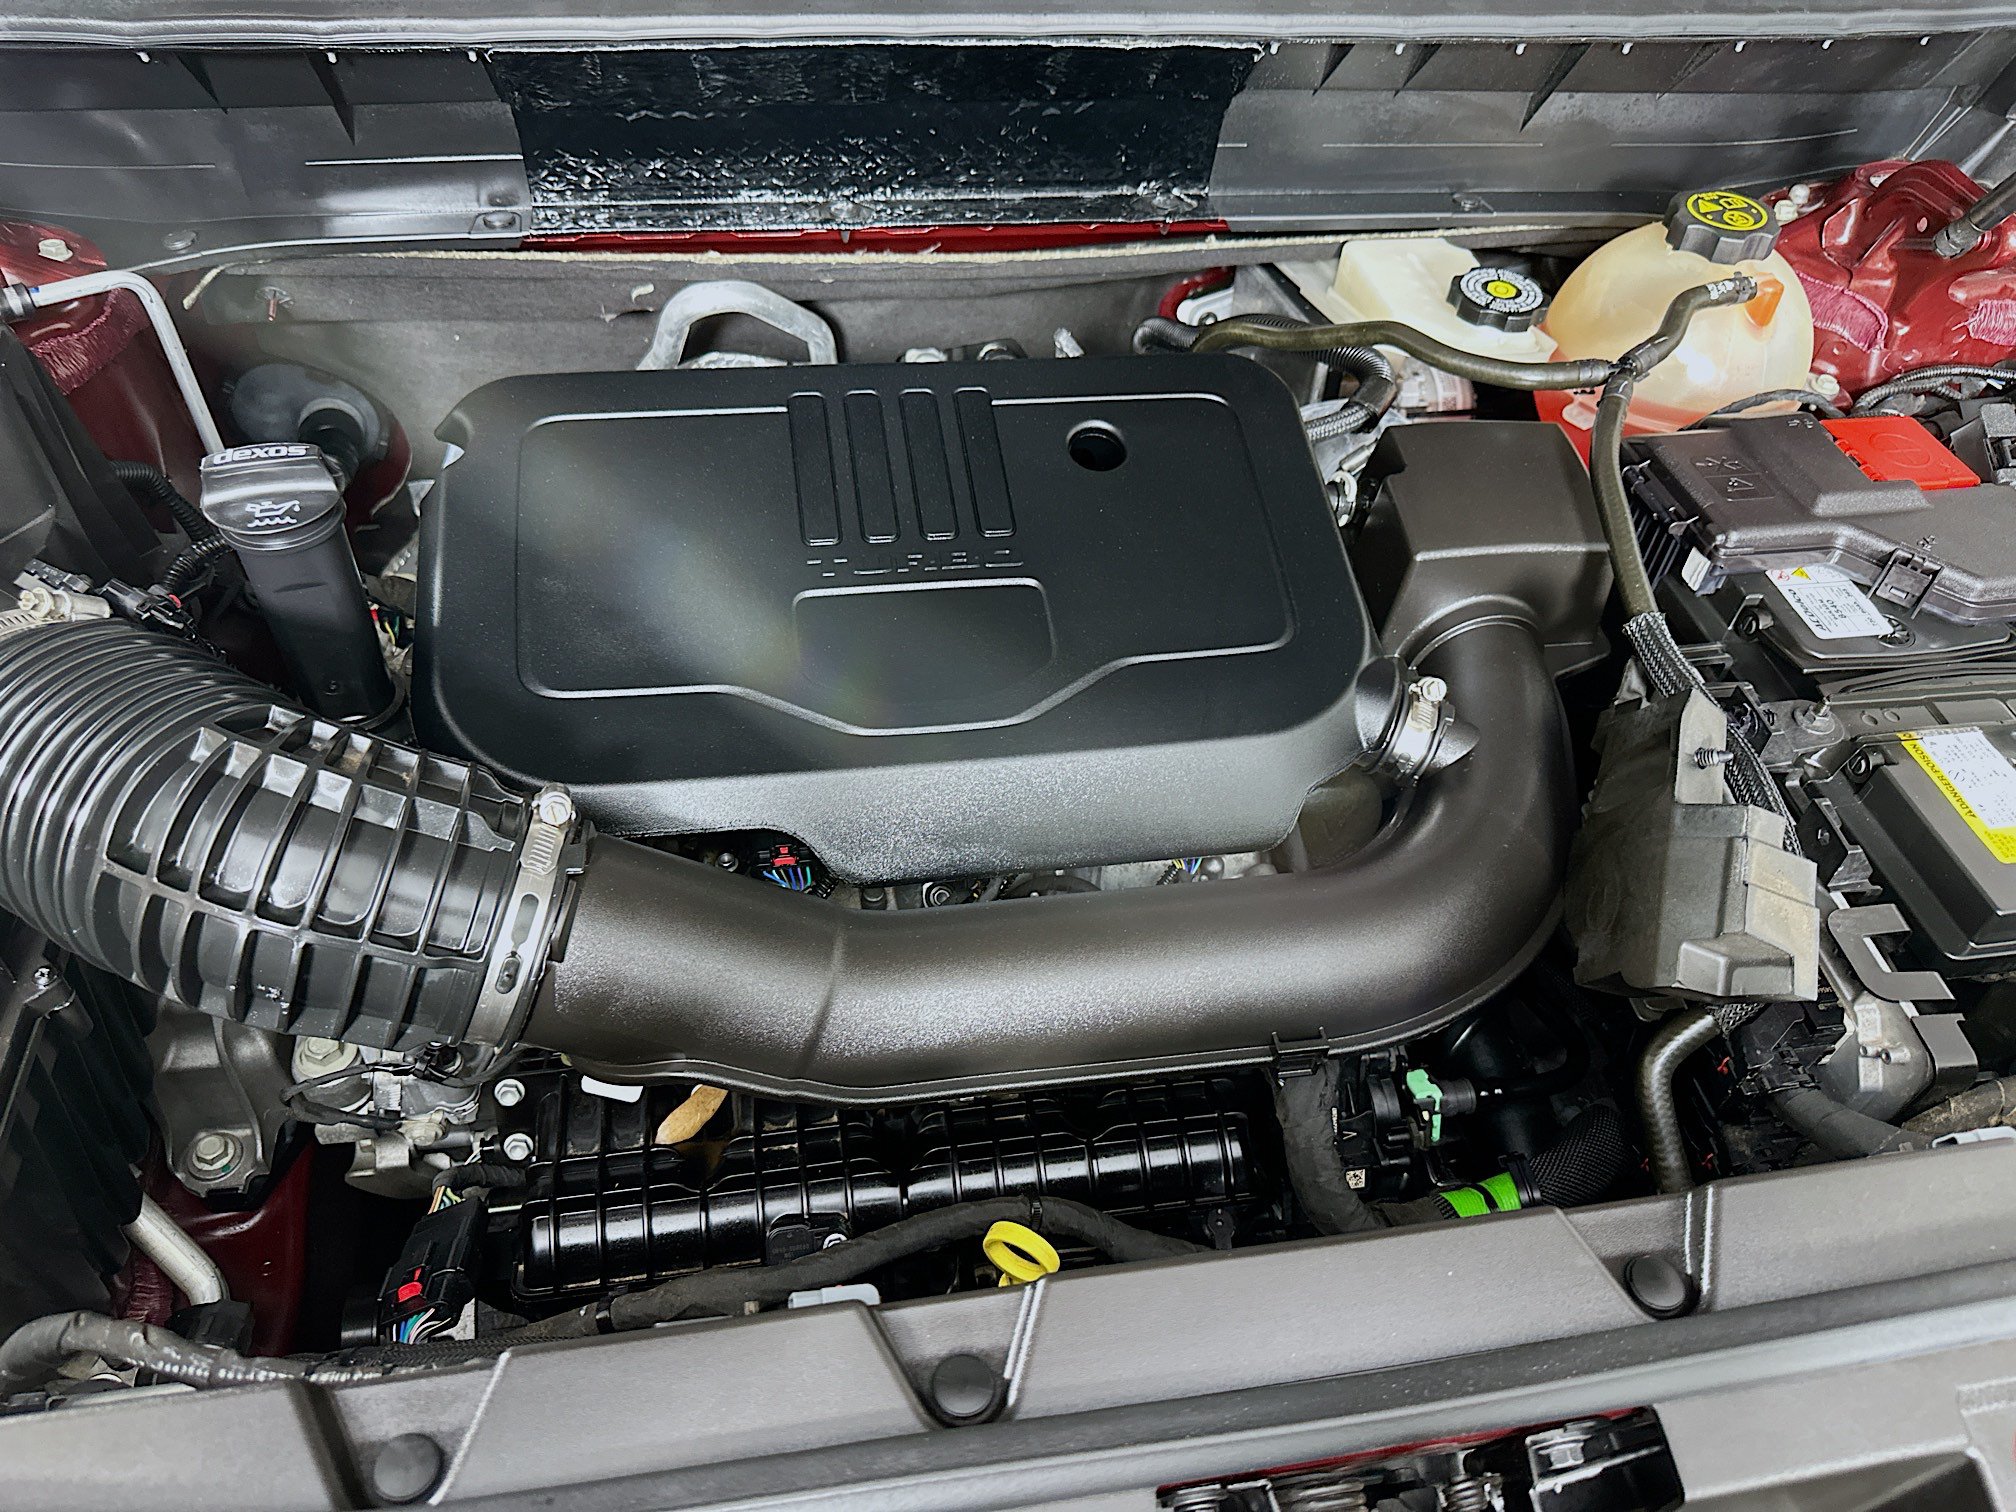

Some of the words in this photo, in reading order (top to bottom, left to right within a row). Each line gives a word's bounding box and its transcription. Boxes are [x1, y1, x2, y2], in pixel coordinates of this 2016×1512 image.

[213, 445, 310, 465] dexos
[1788, 589, 1826, 632] ACDelco
[1910, 743, 1941, 774] POISON
[1937, 774, 1970, 812] DANGER
